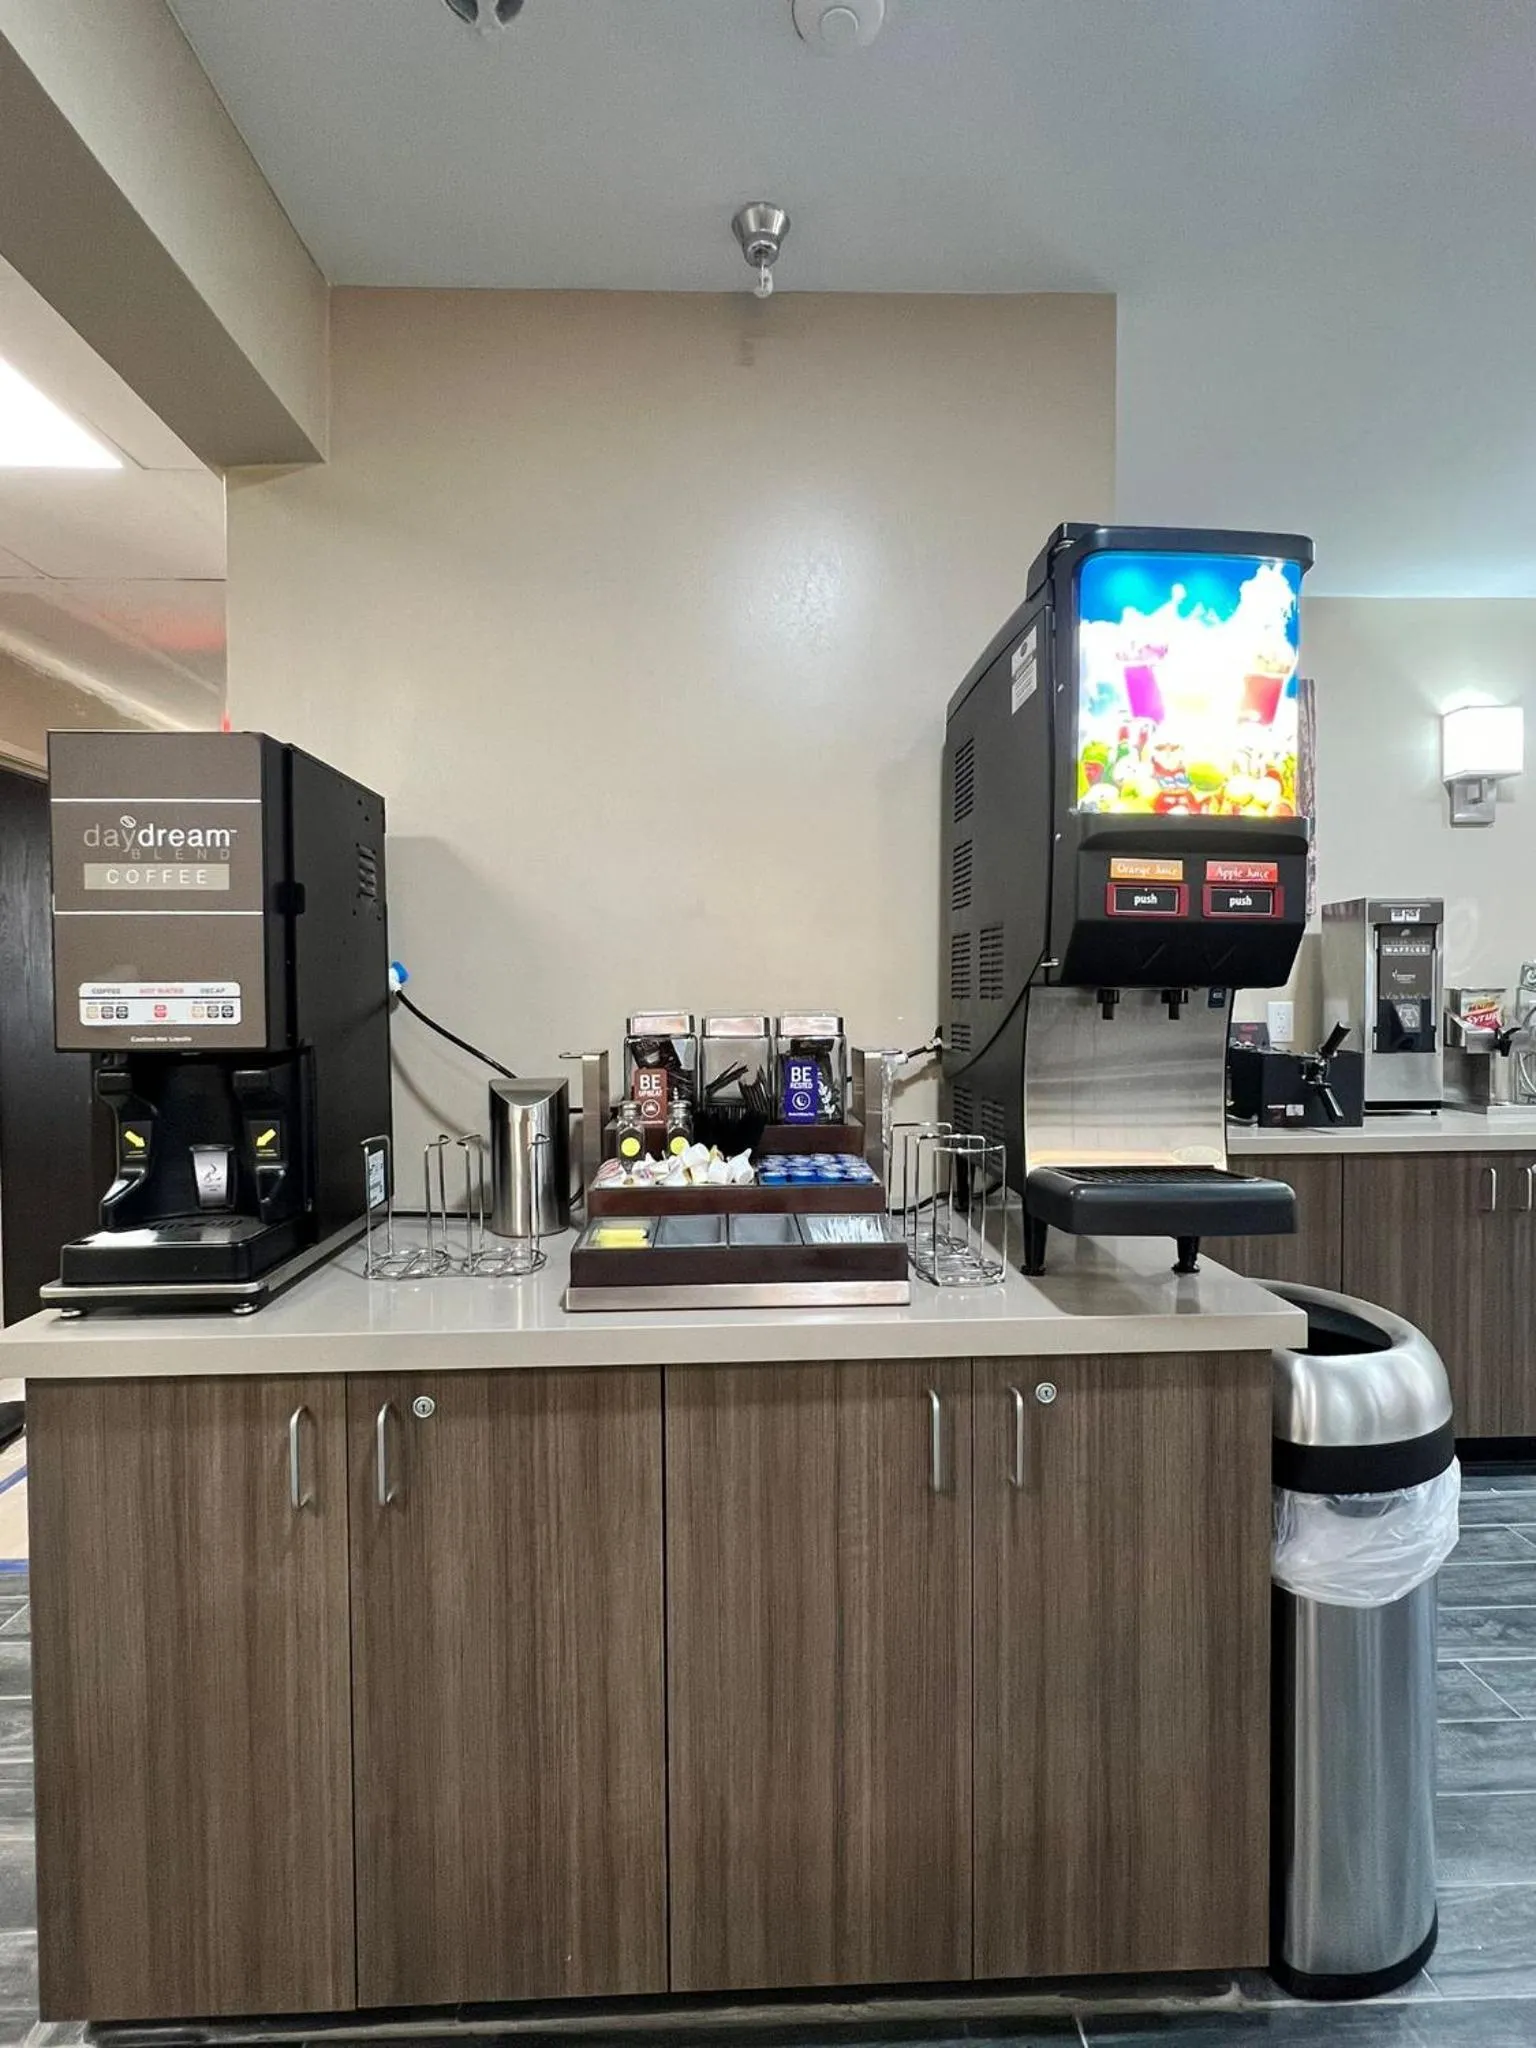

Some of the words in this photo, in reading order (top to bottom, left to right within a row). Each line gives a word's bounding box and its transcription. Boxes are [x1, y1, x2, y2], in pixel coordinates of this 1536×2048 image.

[131, 848, 230, 861] BLEND
[106, 868, 208, 885] COFFEE
[1116, 863, 1151, 876] Orange
[1215, 867, 1241, 882] Apple
[1133, 893, 1158, 907] push
[1228, 895, 1253, 908] push
[790, 1066, 812, 1082] BE
[639, 1074, 661, 1090] BE
